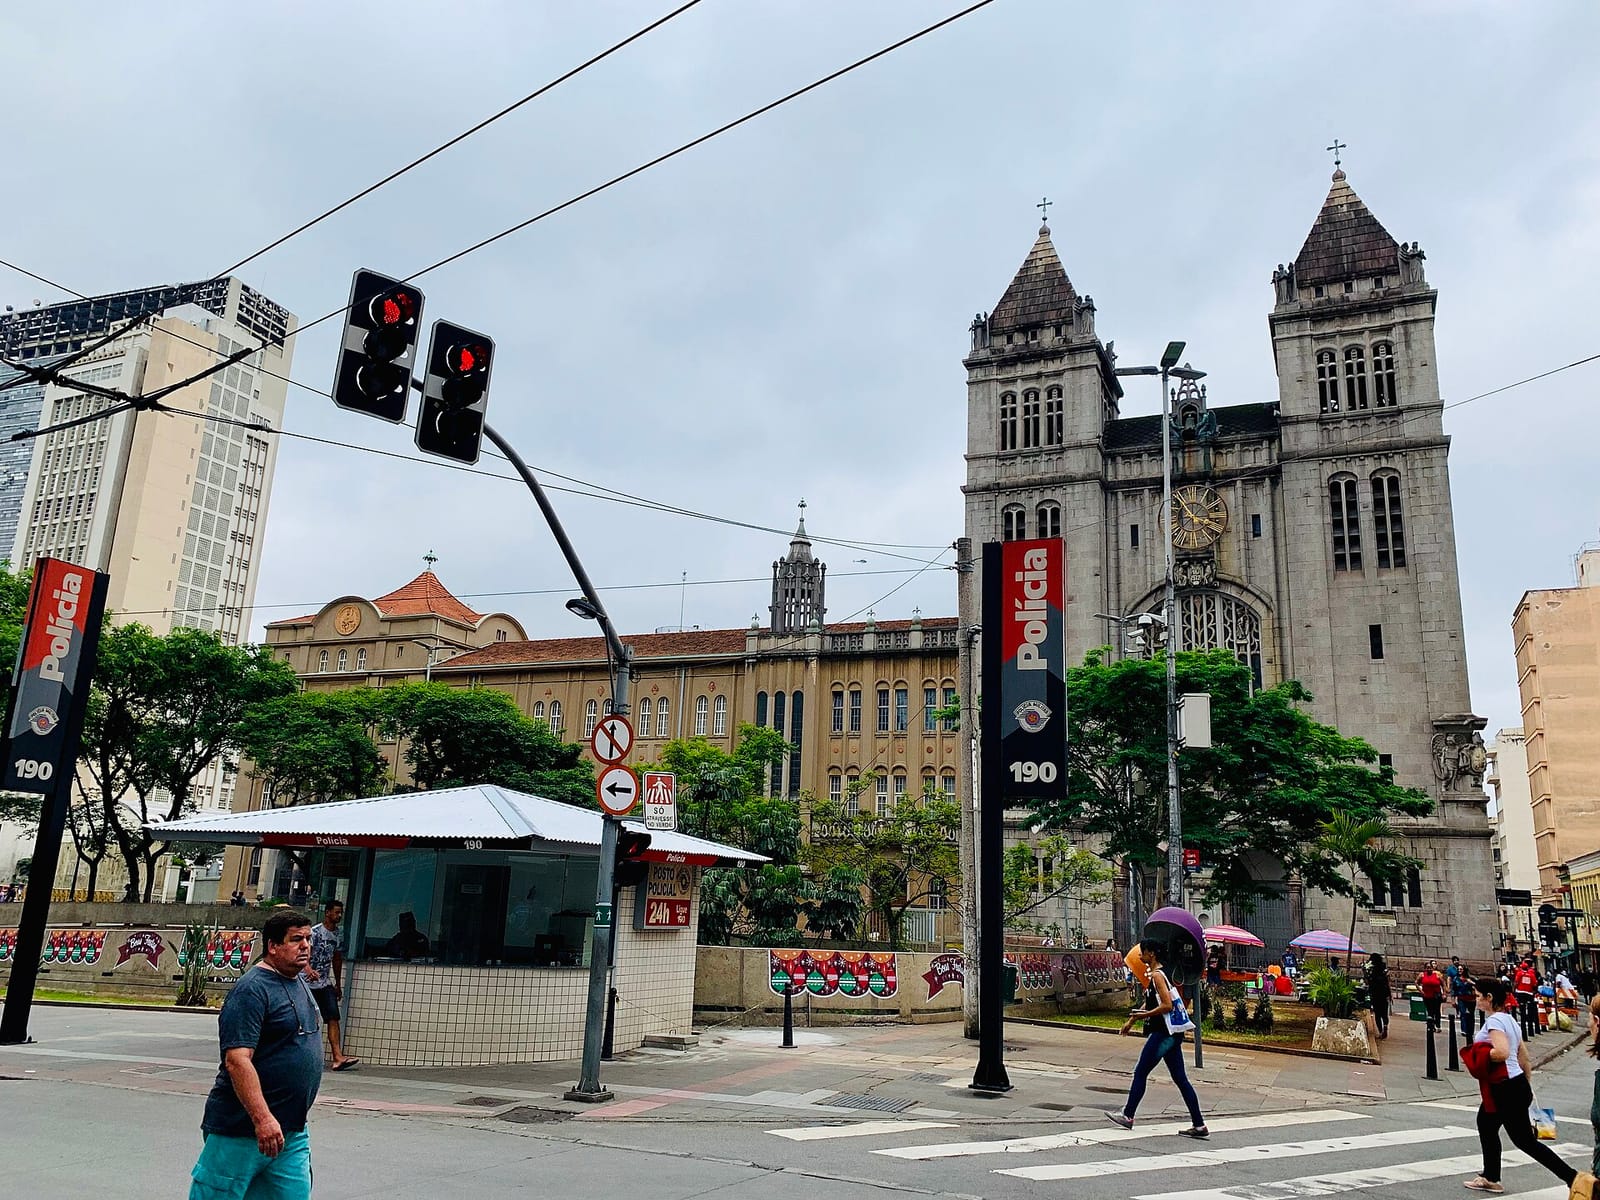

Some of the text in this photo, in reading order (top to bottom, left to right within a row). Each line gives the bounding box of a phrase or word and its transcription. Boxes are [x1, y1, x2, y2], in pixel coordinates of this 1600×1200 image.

[1014, 548, 1048, 671] Polícia
[39, 572, 83, 682] Polícia
[14, 758, 53, 781] 190
[1009, 761, 1057, 783] 190
[653, 805, 665, 815] SÓ
[464, 840, 483, 850] 190
[653, 866, 675, 880] POSTO
[648, 882, 677, 896] POLICIAL
[648, 901, 670, 924] 24h
